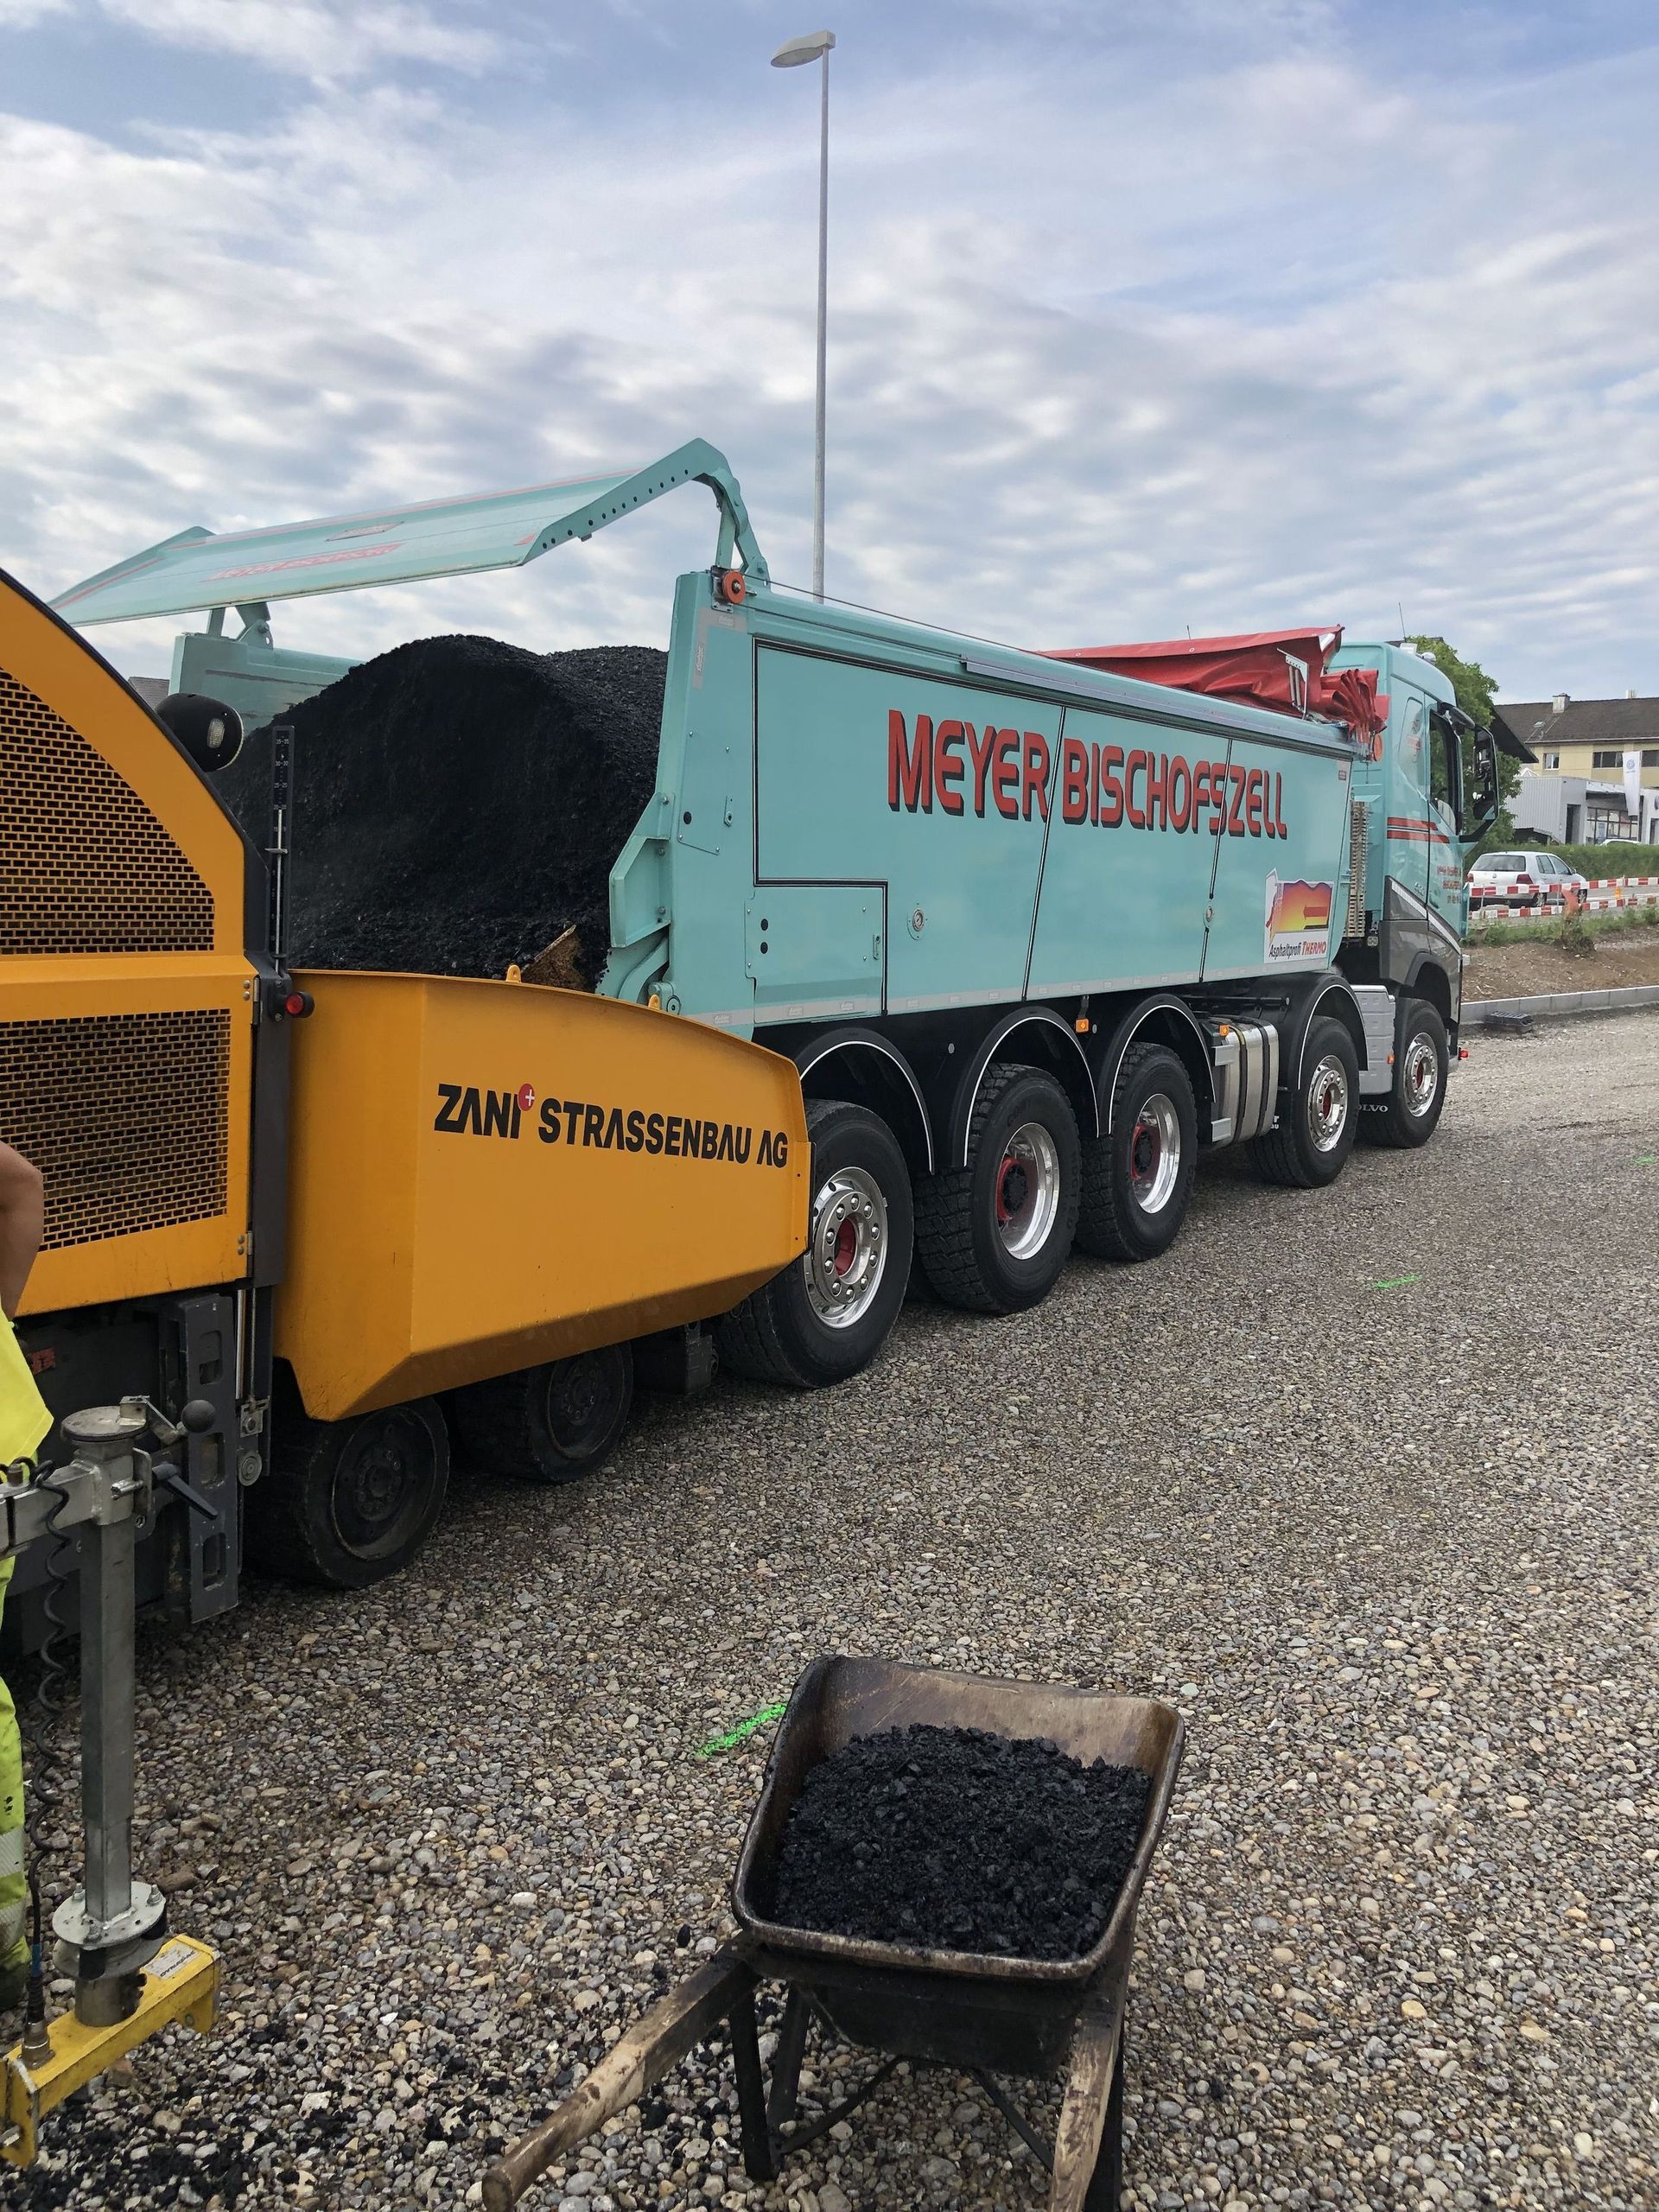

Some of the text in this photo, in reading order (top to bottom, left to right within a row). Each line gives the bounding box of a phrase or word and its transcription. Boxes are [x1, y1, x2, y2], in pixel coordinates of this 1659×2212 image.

[888, 709, 1287, 841] MEYER BISCHOFSZELL
[1302, 941, 1327, 956] THERMO
[433, 1082, 789, 1169] ZANI STRASSENBAU AG
[1357, 1104, 1389, 1113] OLVO
